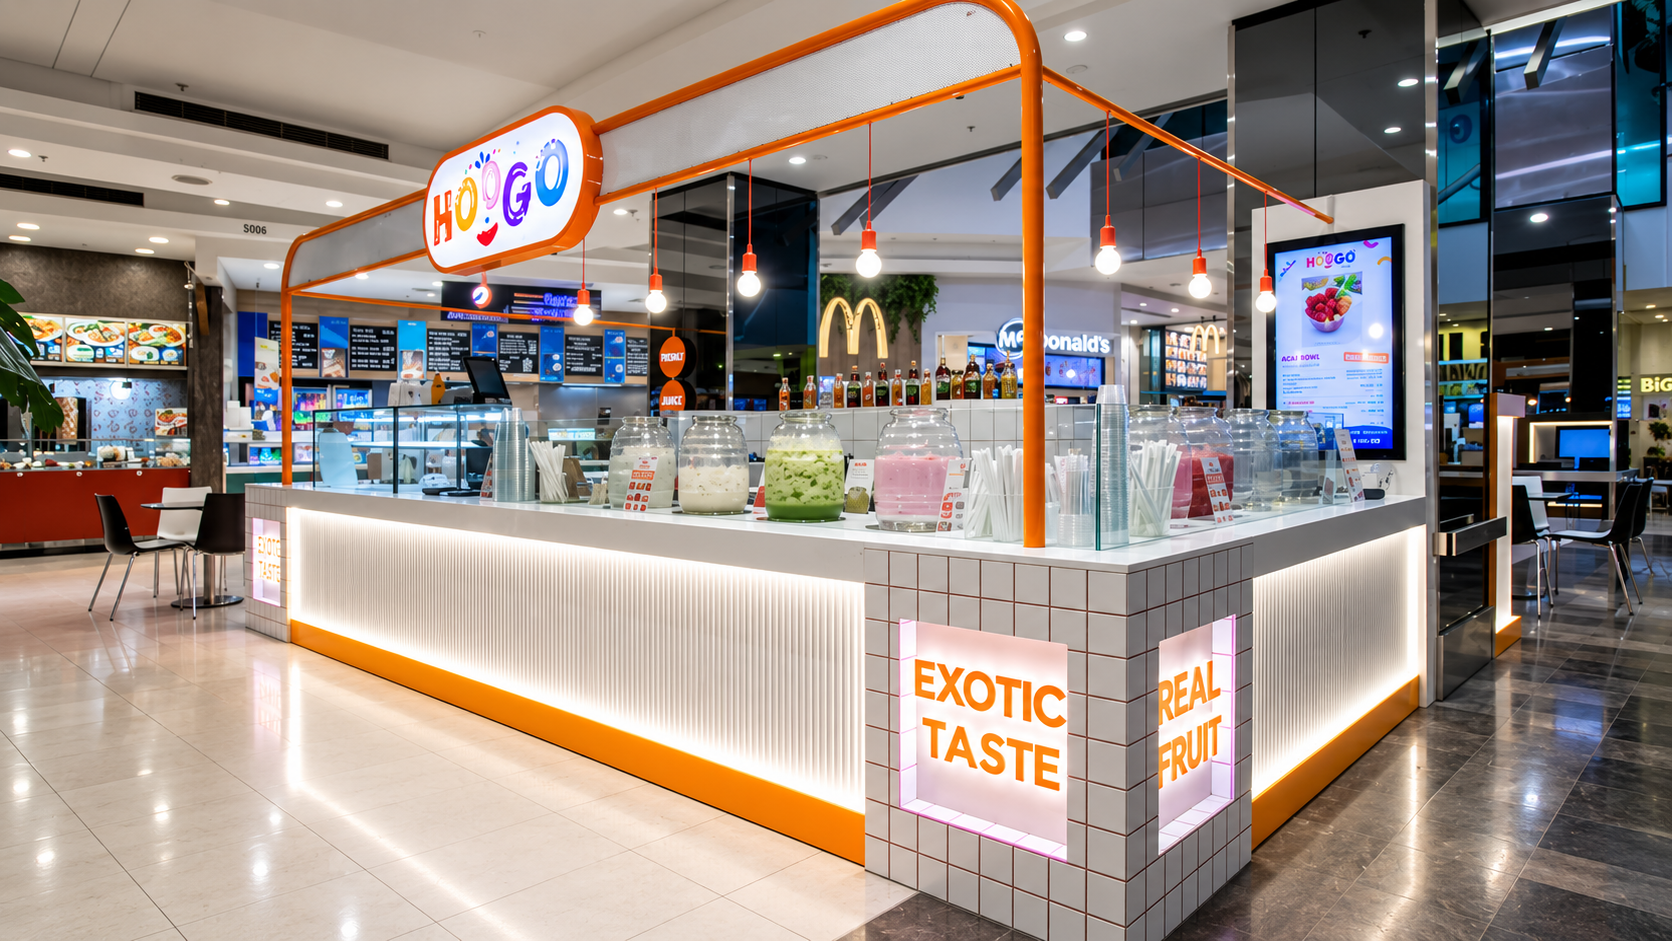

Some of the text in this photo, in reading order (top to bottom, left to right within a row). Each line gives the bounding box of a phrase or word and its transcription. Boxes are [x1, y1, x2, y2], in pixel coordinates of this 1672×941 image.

[243, 223, 267, 235] S006
[914, 658, 1067, 728] EXOTIC
[1158, 660, 1221, 726] REAL
[922, 717, 1060, 792] TASTE
[1158, 715, 1222, 790] FRUIT
